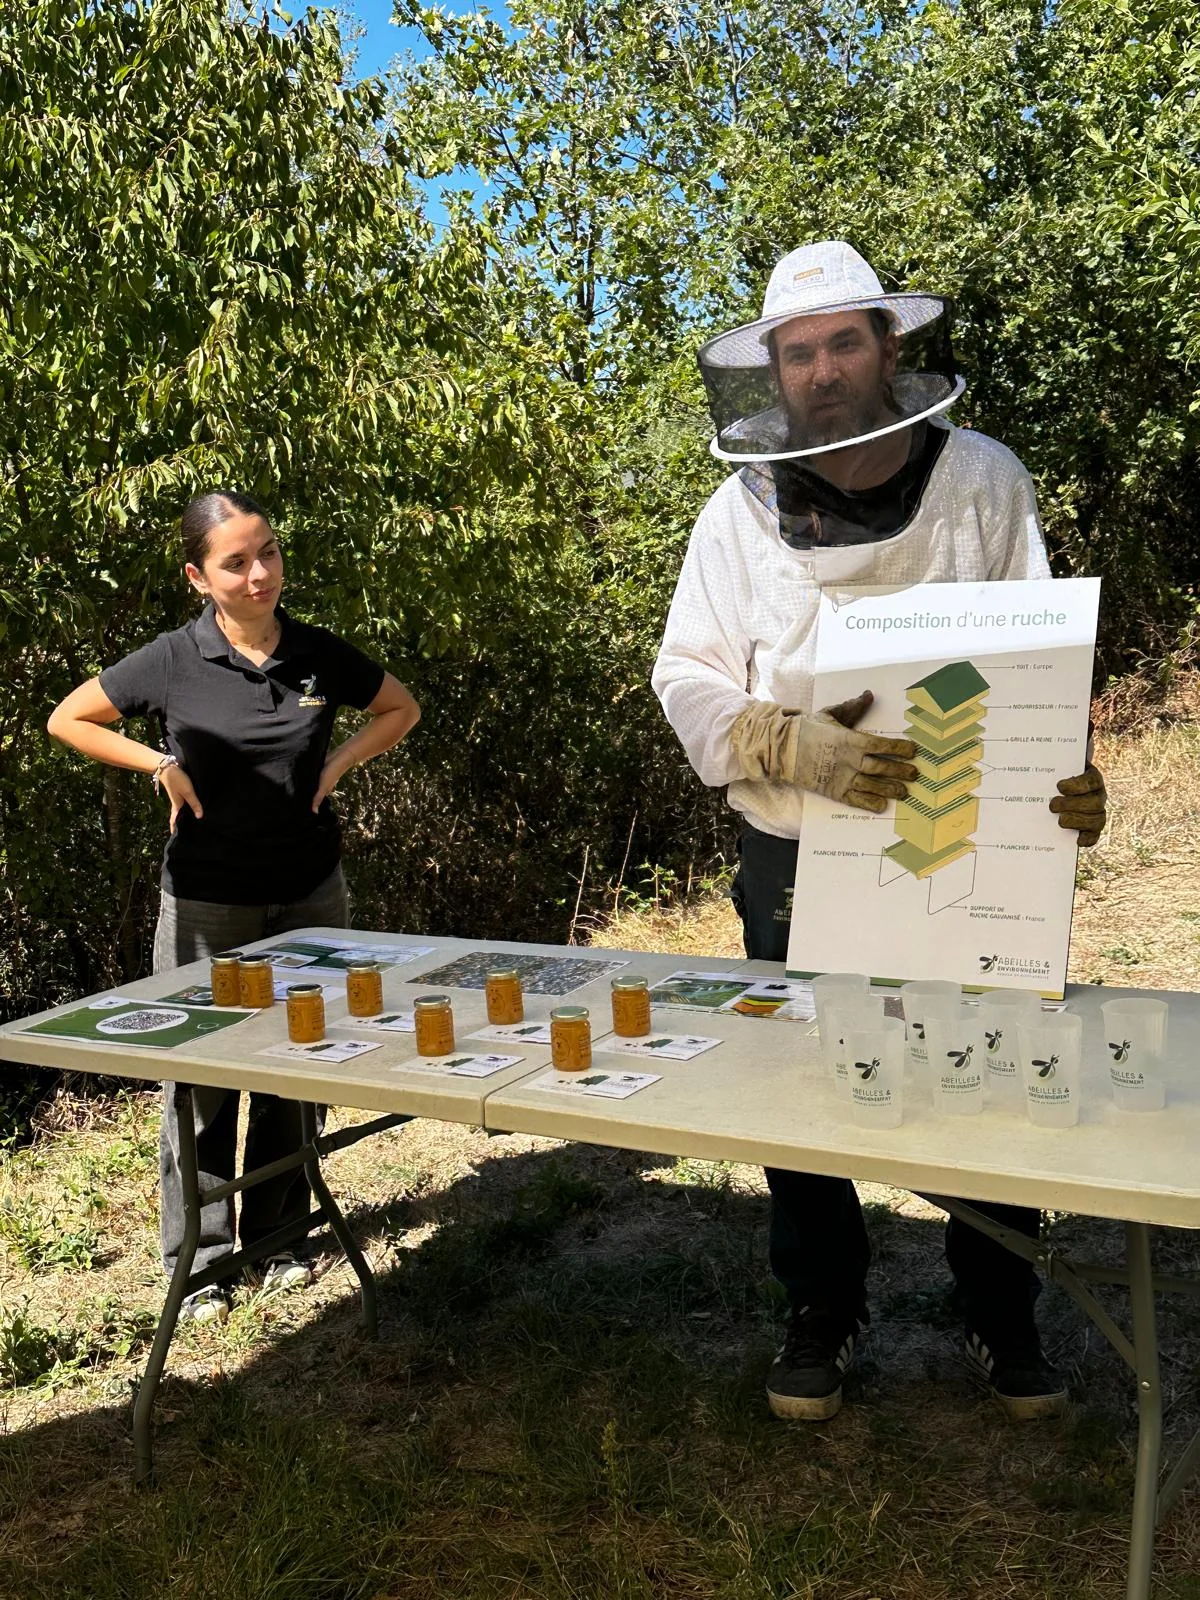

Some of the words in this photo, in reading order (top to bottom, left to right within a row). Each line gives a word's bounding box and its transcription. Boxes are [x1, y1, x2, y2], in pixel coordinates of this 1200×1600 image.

[845, 611, 951, 633] Composition
[956, 611, 1006, 628] d'une
[1011, 608, 1067, 627] ruche
[1033, 663, 1054, 671] Europe
[1035, 766, 1056, 774] Europe
[1025, 796, 1045, 804] CORPS
[852, 814, 871, 822] Europe
[1000, 844, 1031, 852] PLANCHER
[813, 849, 837, 857] PLANCHE
[1025, 914, 1046, 922] France
[998, 957, 1041, 968] ABEILLES
[997, 965, 1051, 975] ENVIRONNEMENT
[941, 1076, 976, 1085] ABEILLES
[1028, 1084, 1063, 1095] ABEILLES
